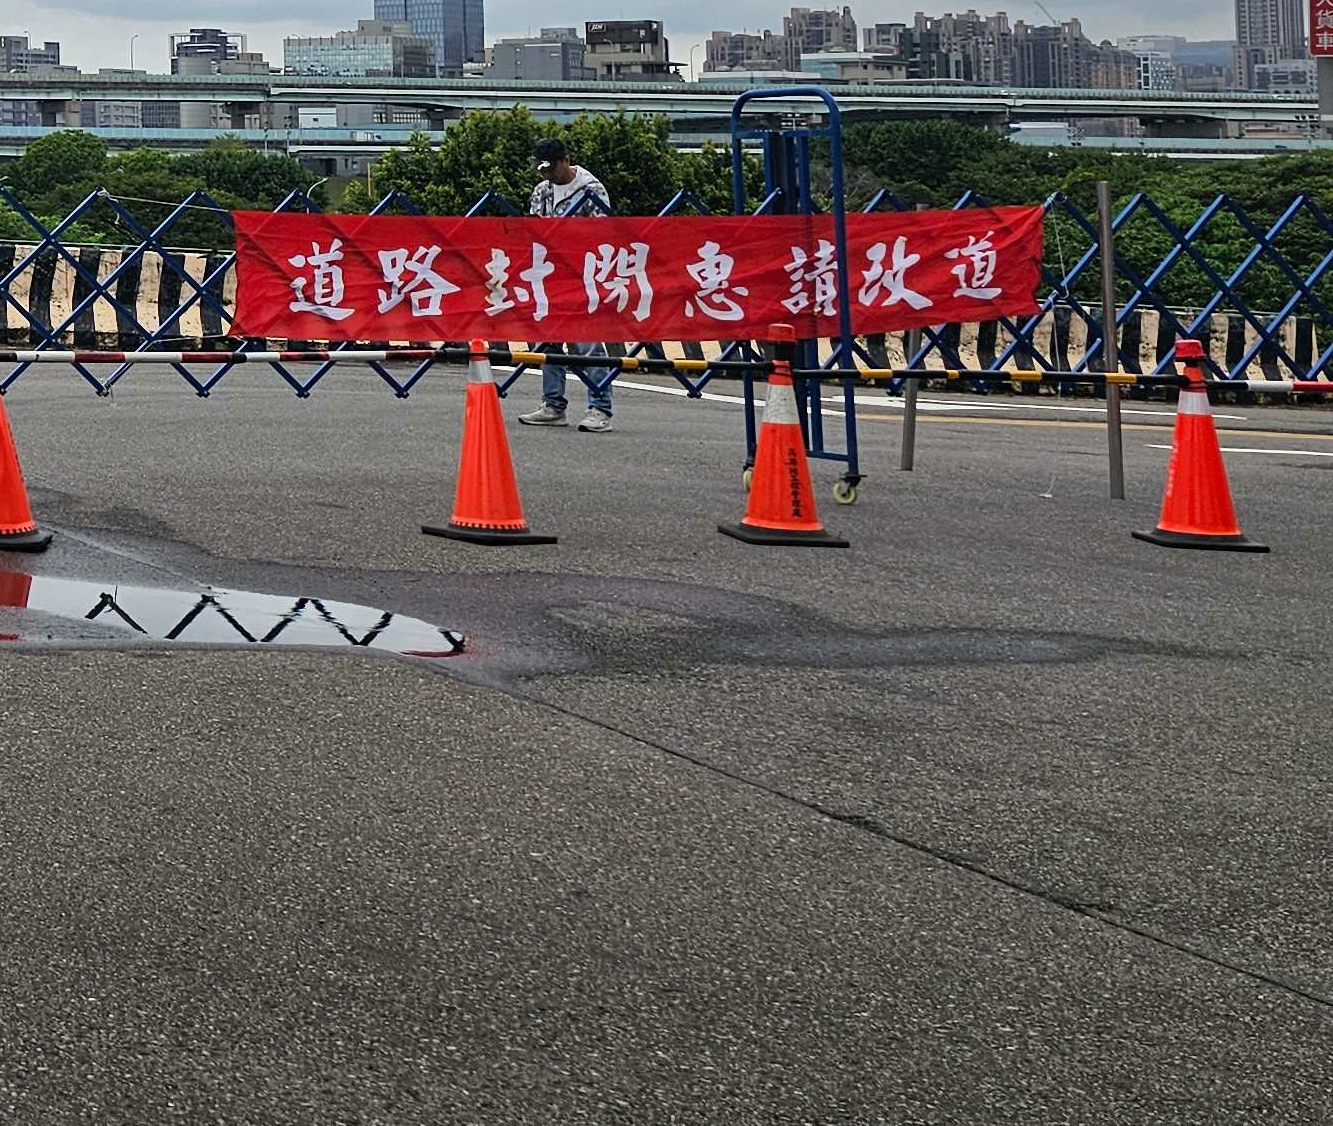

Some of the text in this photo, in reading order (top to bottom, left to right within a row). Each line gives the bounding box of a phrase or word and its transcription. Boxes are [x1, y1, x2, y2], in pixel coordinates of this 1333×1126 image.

[287, 229, 1003, 323] 道路封閉惠請改道
